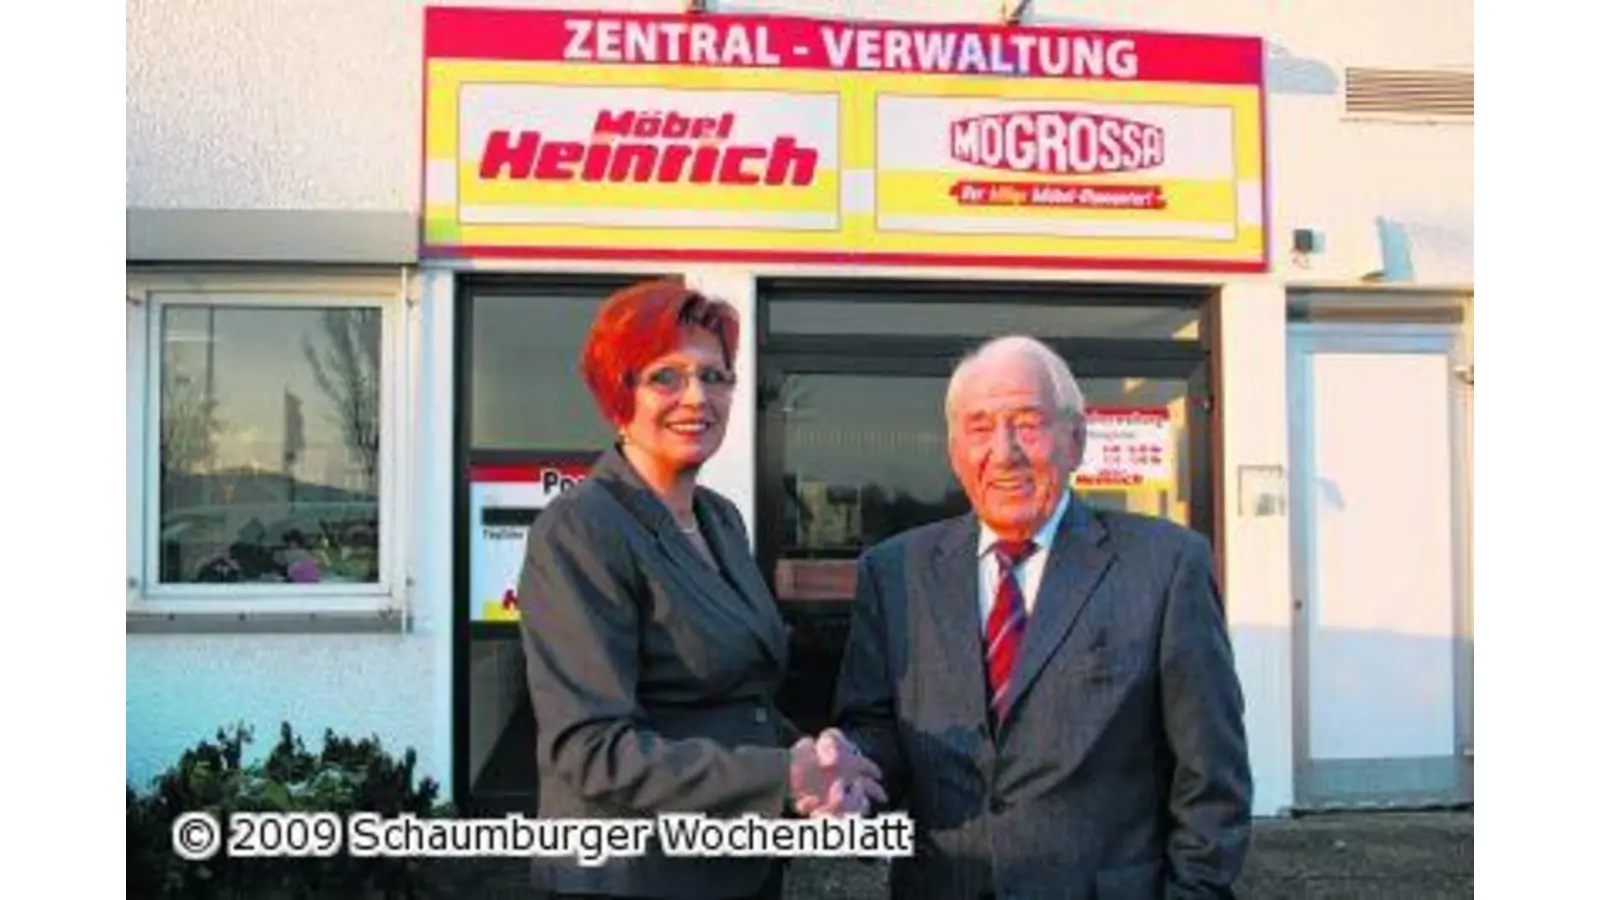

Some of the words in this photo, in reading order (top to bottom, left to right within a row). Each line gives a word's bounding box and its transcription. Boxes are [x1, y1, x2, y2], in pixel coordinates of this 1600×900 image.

[563, 18, 780, 65] ZENTRAL
[822, 28, 1138, 78] VERWALTUNG
[594, 109, 735, 139] Möbel
[479, 130, 819, 187] Heinrich
